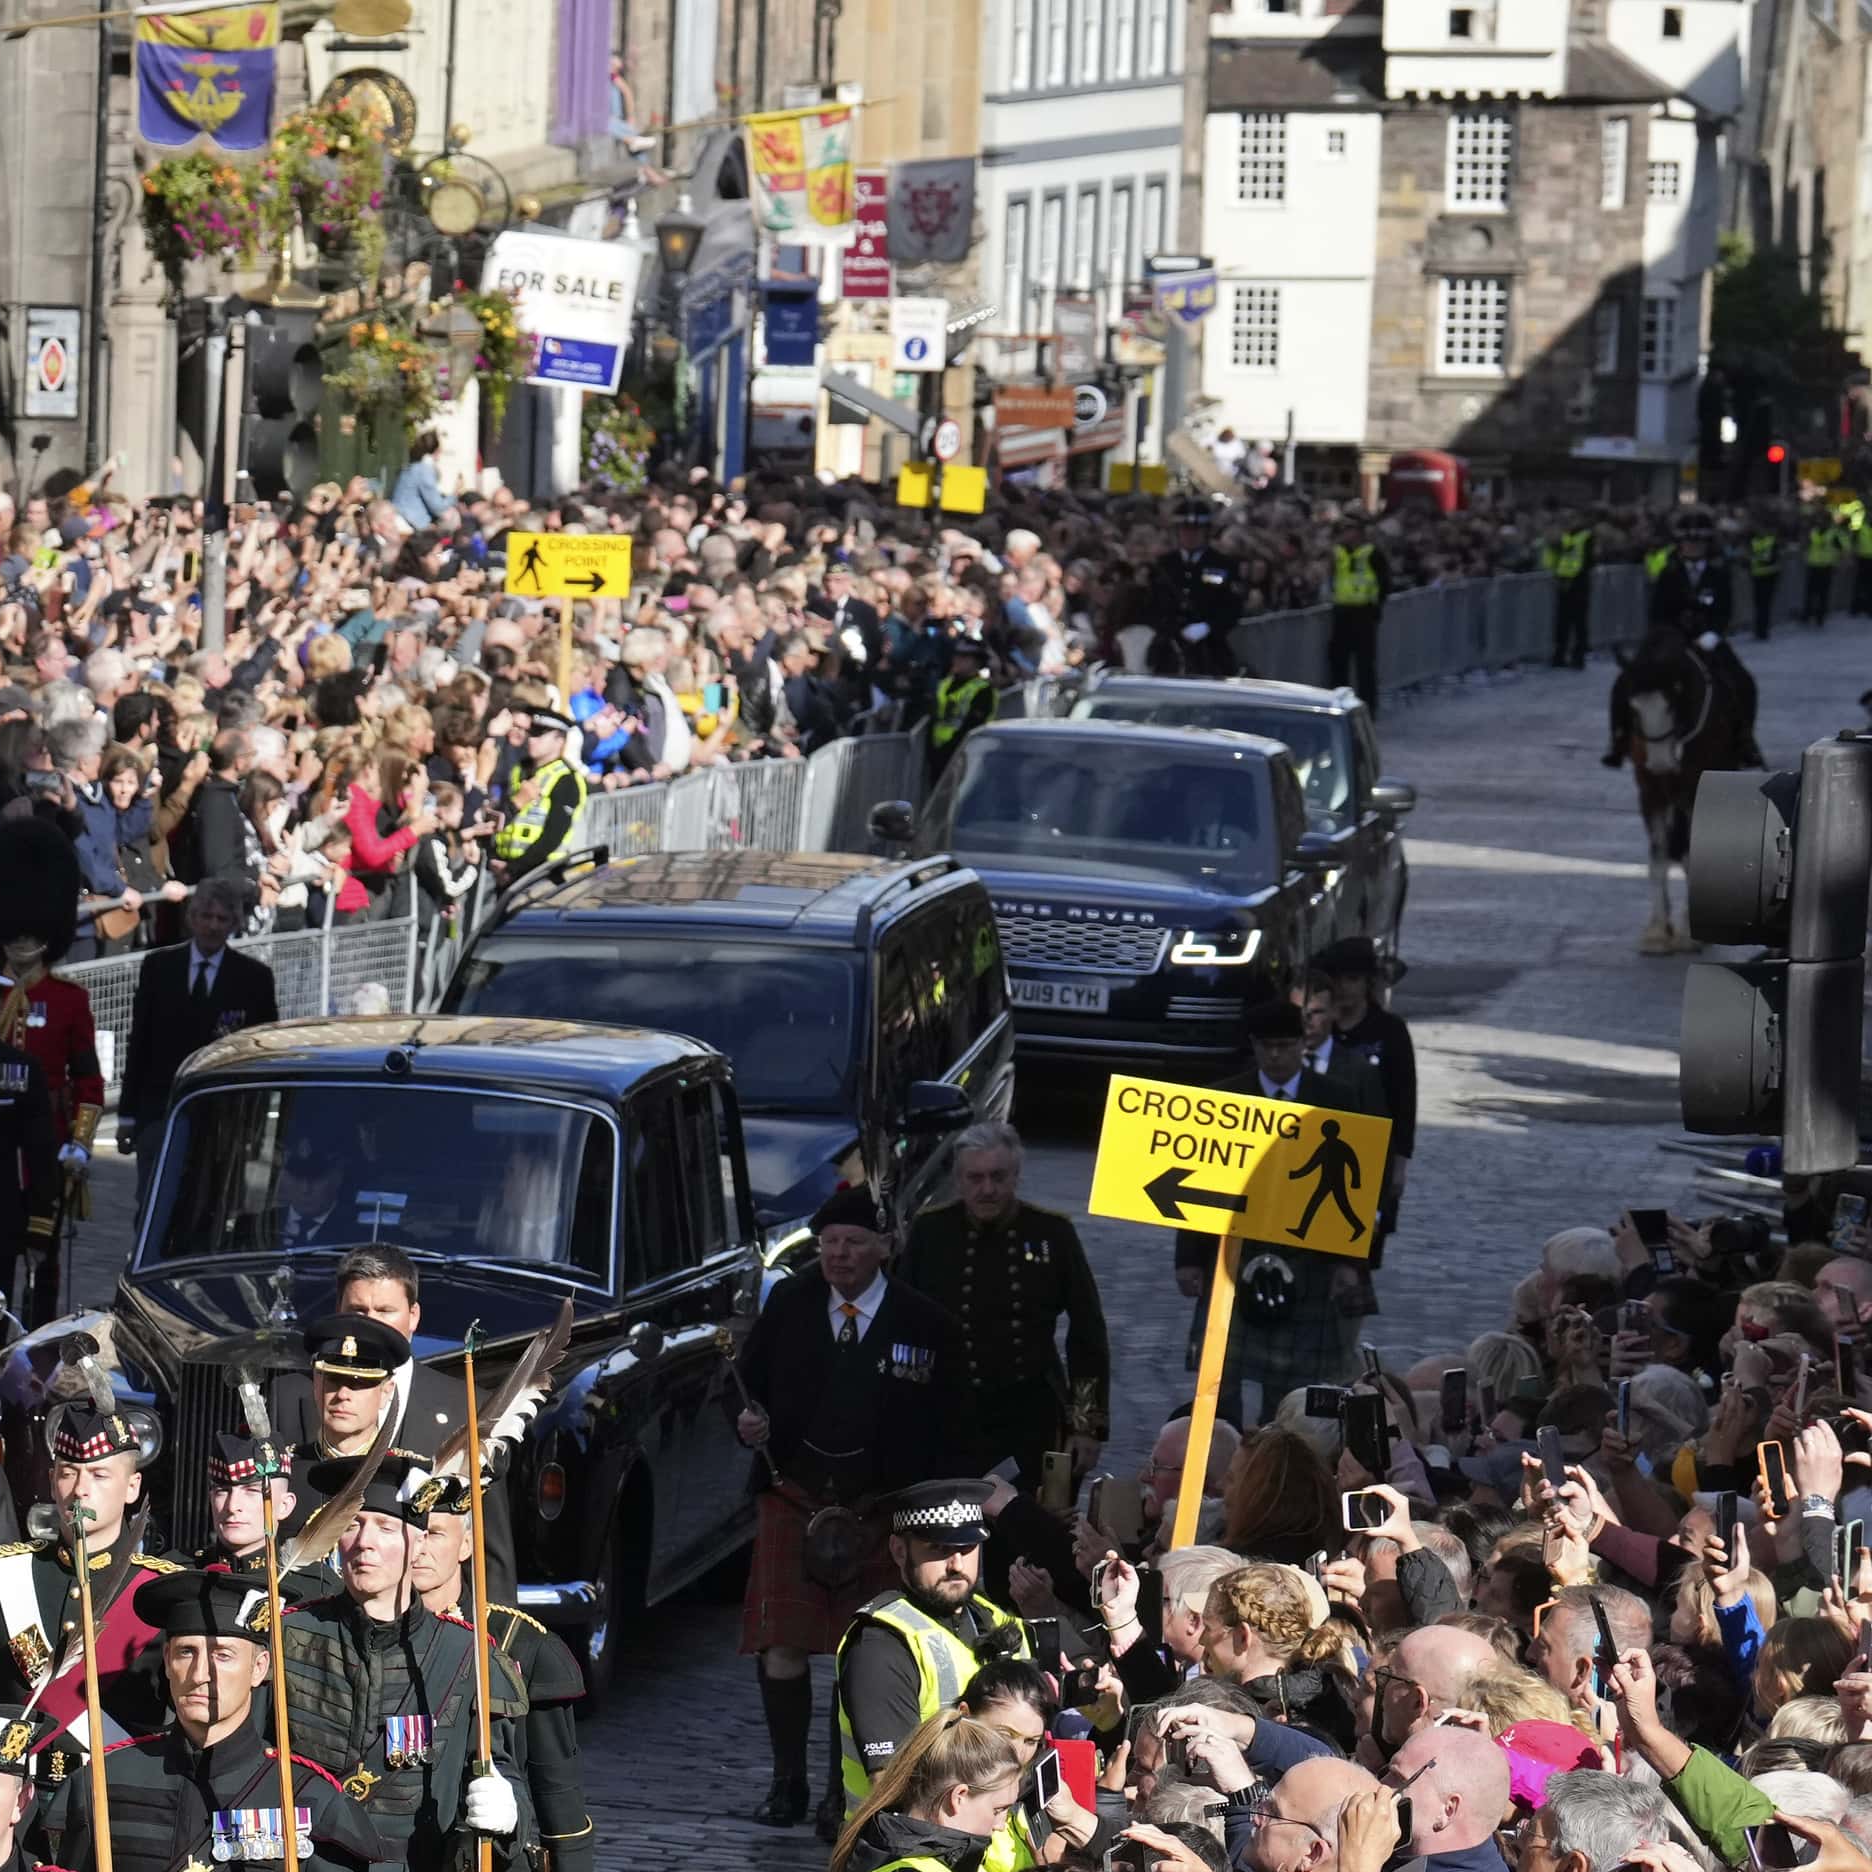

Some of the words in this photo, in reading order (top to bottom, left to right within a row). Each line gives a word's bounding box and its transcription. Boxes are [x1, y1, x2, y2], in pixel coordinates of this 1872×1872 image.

[498, 268, 546, 292] FOR
[554, 273, 623, 301] SALE
[547, 537, 628, 552] CROSSING
[564, 554, 609, 567] POINT
[1059, 985, 1100, 1008] CYH
[1117, 1087, 1302, 1140] CROSSING
[1149, 1128, 1255, 1169] POINT
